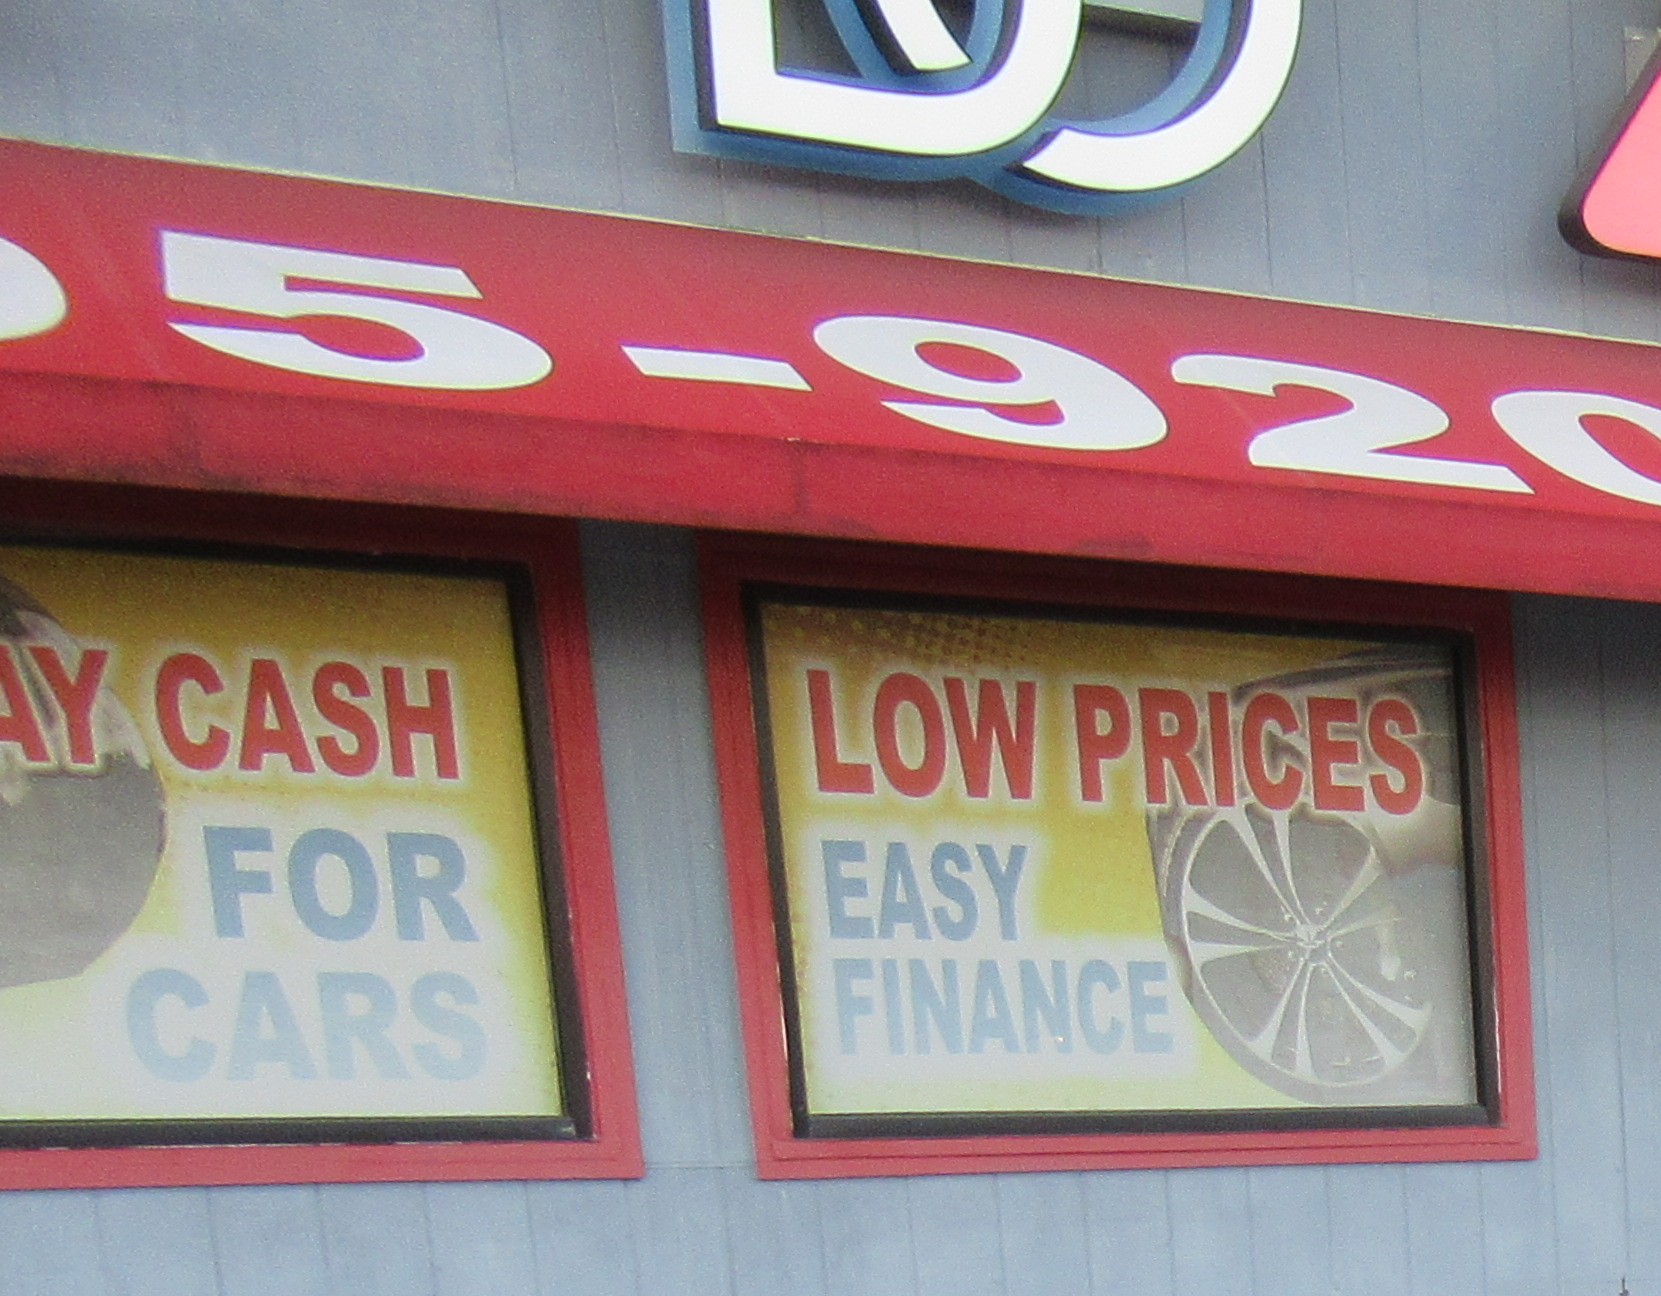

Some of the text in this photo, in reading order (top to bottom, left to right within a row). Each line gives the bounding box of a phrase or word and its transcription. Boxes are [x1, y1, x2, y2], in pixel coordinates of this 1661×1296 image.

[155, 652, 460, 780] CASH
[805, 668, 1424, 815] LOW PRICES
[202, 824, 480, 943] FOR
[822, 840, 1030, 942] EASY
[125, 967, 489, 1083] CARS
[832, 958, 1175, 1057] FINANCE
